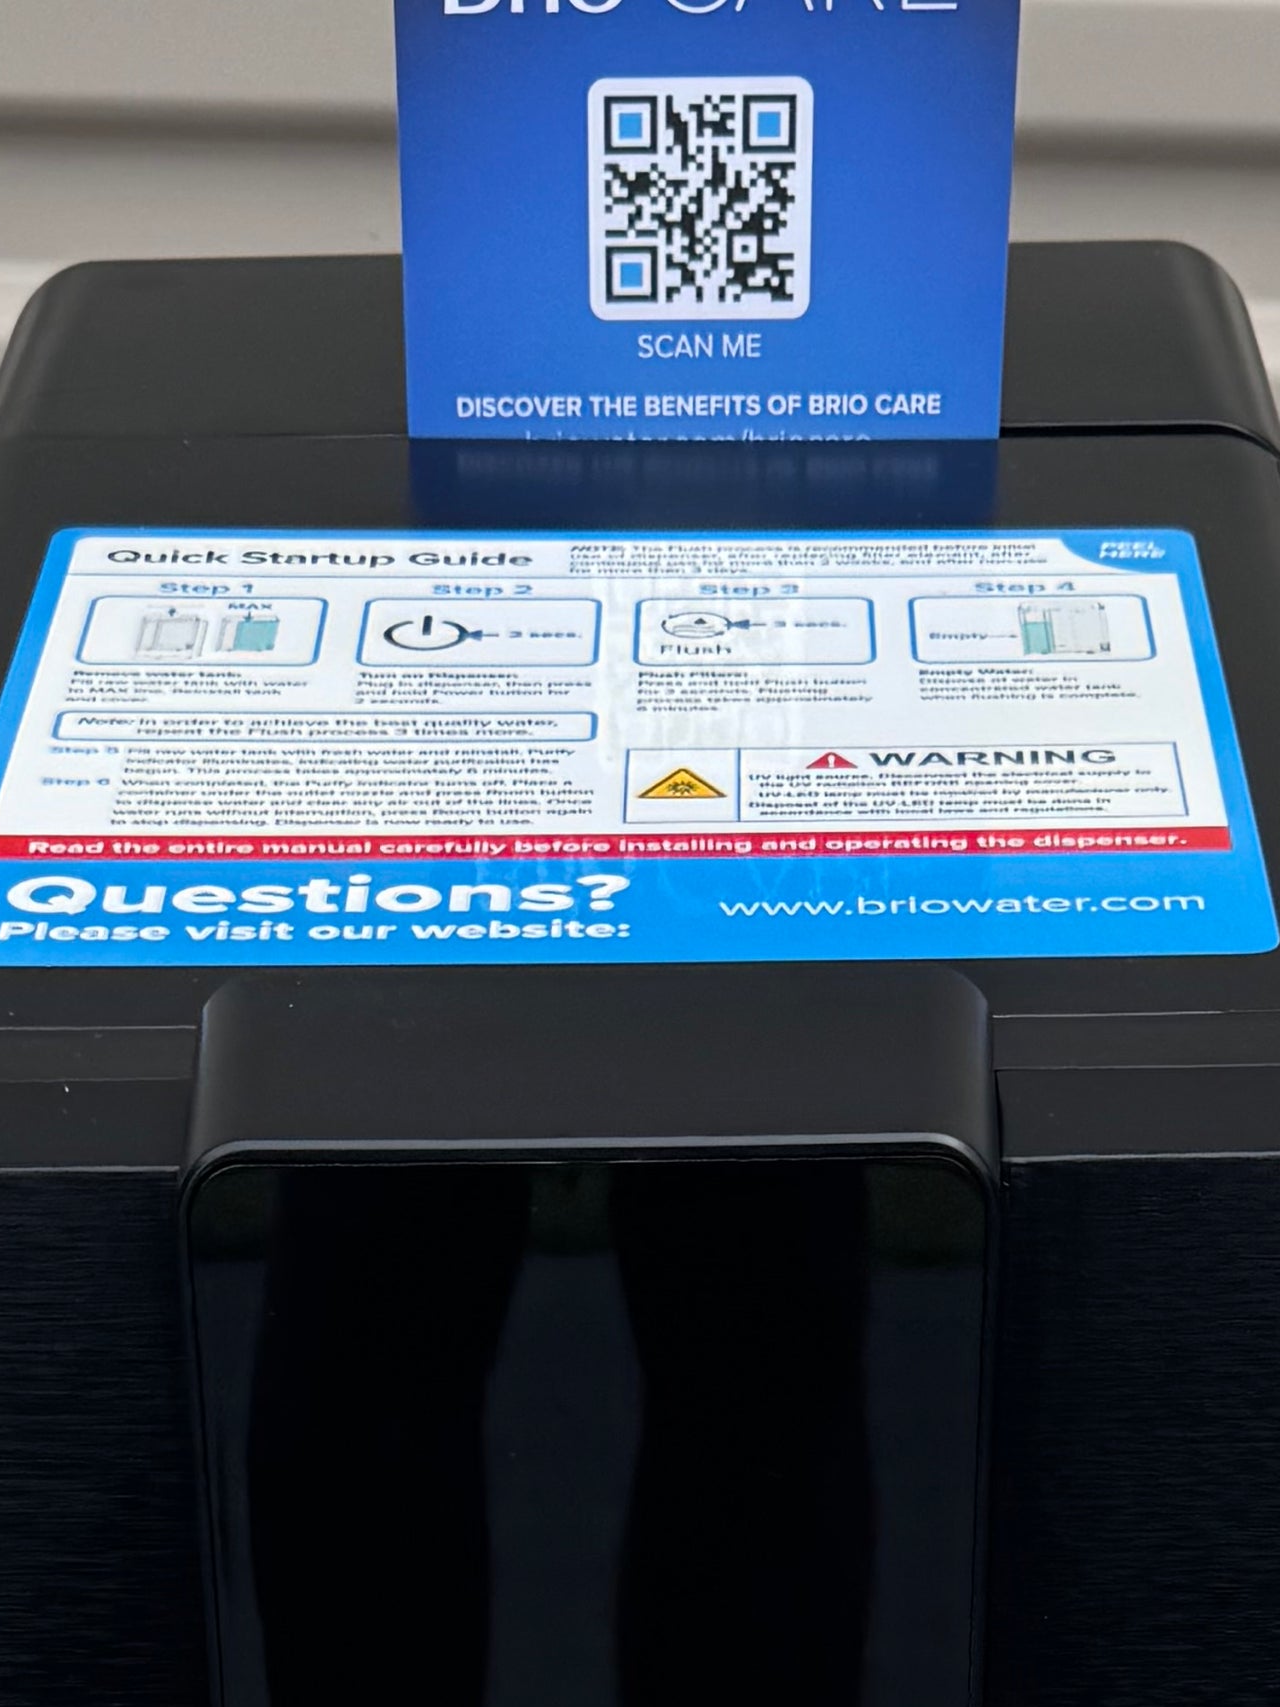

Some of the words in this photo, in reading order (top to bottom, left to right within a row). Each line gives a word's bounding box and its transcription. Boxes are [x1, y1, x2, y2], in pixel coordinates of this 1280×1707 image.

[637, 335, 713, 359] SCAN
[721, 334, 762, 358] ME
[455, 396, 582, 418] DISCOVER
[589, 396, 637, 417] THE
[643, 395, 761, 417] BENEFITS
[767, 395, 802, 416] OF
[808, 394, 869, 415] BRIO
[874, 394, 942, 415] CARE
[107, 549, 230, 565] Quick
[240, 552, 395, 568] Startup
[408, 552, 534, 567] Guide
[159, 583, 231, 597] Step
[236, 583, 254, 594] 1
[431, 584, 503, 597] Step
[515, 584, 534, 596] 2
[699, 583, 772, 597] Step
[780, 583, 799, 595] 3
[974, 582, 1046, 595] Step
[1057, 581, 1075, 591] 4
[660, 644, 732, 656] Flush
[77, 717, 134, 725] Note:
[138, 717, 157, 725] In
[162, 718, 219, 726] order
[223, 718, 244, 726] to
[250, 718, 330, 726] achieve
[335, 718, 368, 726] the
[374, 718, 418, 727] best
[424, 718, 493, 728] quality
[496, 718, 558, 728] water,
[868, 749, 1118, 768] WARNING
[27, 841, 105, 854] Read
[111, 841, 161, 854] the
[167, 841, 255, 854] entire
[261, 840, 373, 854] manual
[378, 840, 507, 856] carefully
[514, 839, 611, 853] before
[619, 838, 753, 854] installing
[761, 837, 817, 851] and
[824, 835, 969, 852] operating
[976, 834, 1026, 848] the
[1033, 832, 1188, 849] dispenser.
[6, 873, 632, 916] Questions?
[718, 895, 1207, 918] www.briowater.com
[184, 920, 295, 941] visit
[307, 924, 397, 941] our
[409, 919, 633, 940] website:
